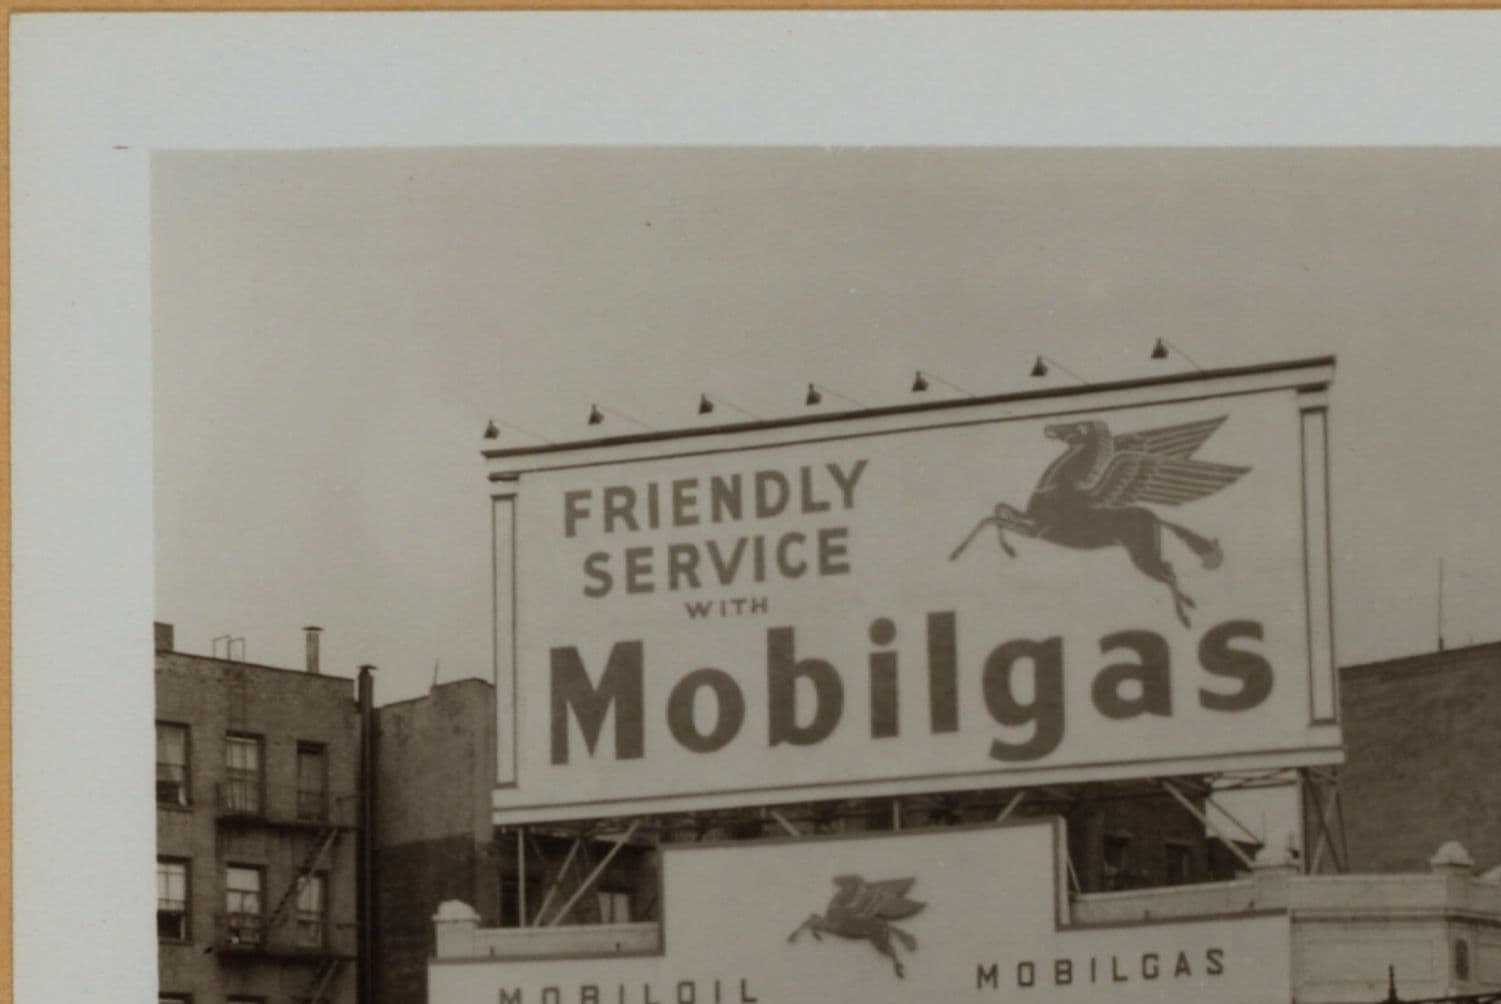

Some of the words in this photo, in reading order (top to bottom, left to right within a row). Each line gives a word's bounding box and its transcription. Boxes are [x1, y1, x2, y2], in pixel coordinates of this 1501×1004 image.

[563, 459, 869, 539] FRIENDLY
[583, 528, 850, 599] SERVICE
[685, 597, 768, 619] WITH
[549, 610, 1275, 765] Mobilgas
[976, 947, 1225, 991] MOBILGAS
